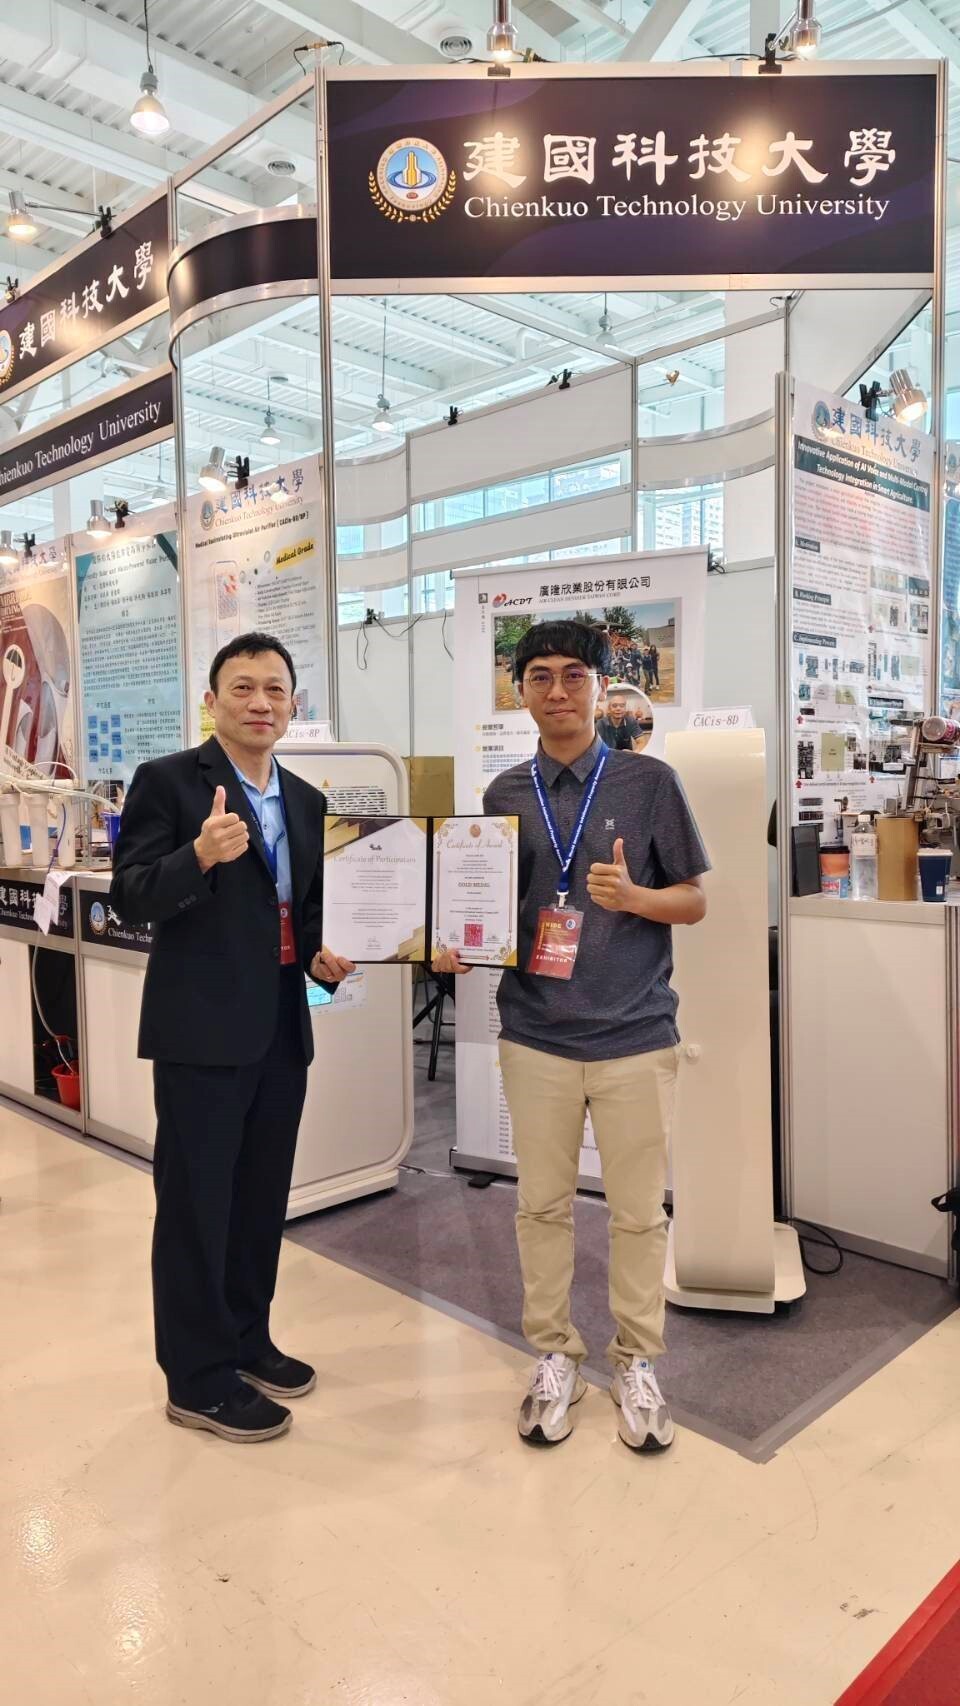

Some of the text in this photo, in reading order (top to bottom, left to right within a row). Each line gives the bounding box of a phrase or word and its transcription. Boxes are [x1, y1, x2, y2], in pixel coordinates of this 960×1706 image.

[463, 128, 896, 188] 建國科技大學
[464, 194, 889, 221] Chienkuo Technology University
[19, 241, 154, 359] 建國科技大學
[0, 401, 161, 486] hienkuo Technology University
[832, 406, 921, 463] 建國科技大學
[798, 439, 825, 458] Innovative
[826, 450, 854, 469] Application
[854, 460, 861, 471] of
[861, 462, 867, 471] AI
[816, 464, 845, 483] Technology
[845, 474, 873, 490] Integration
[276, 541, 314, 565] Medical Grade
[504, 597, 533, 607] ACDT
[446, 840, 473, 850] Certificate
[108, 927, 135, 940] Chienkuo
